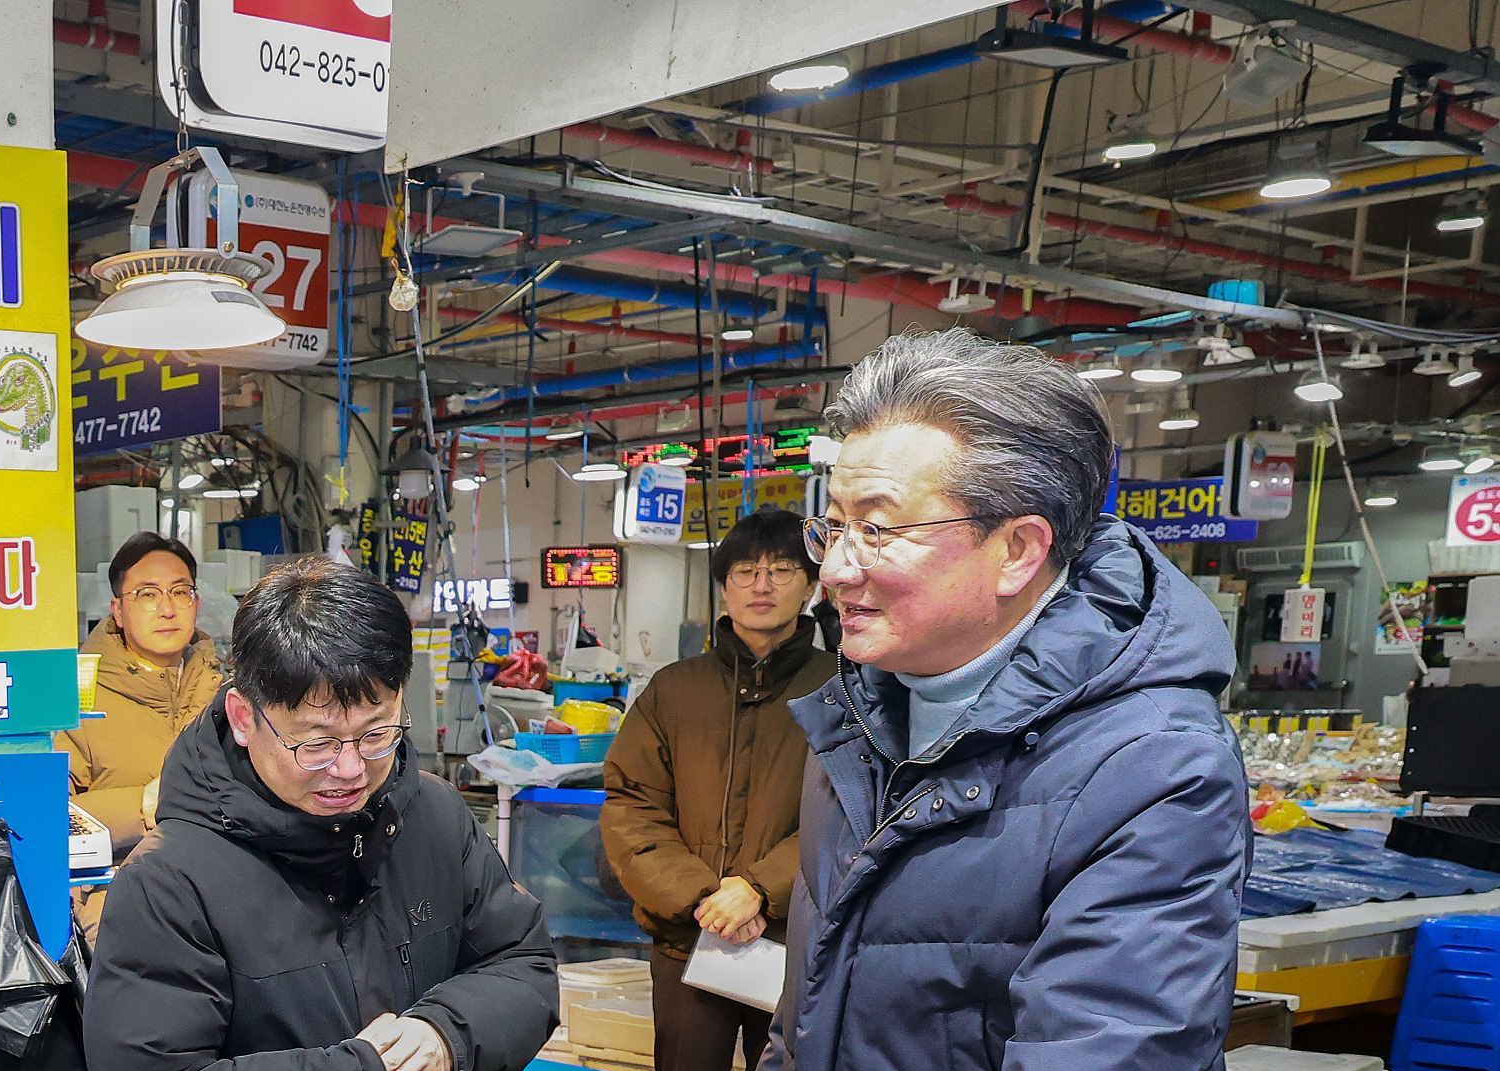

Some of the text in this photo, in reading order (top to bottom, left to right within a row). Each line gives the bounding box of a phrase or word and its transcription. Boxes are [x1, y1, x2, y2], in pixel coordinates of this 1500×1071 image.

[260, 40, 390, 92] 042-825-0
[252, 240, 312, 311] 27
[74, 406, 161, 445] 477-7742
[655, 493, 679, 520] 15
